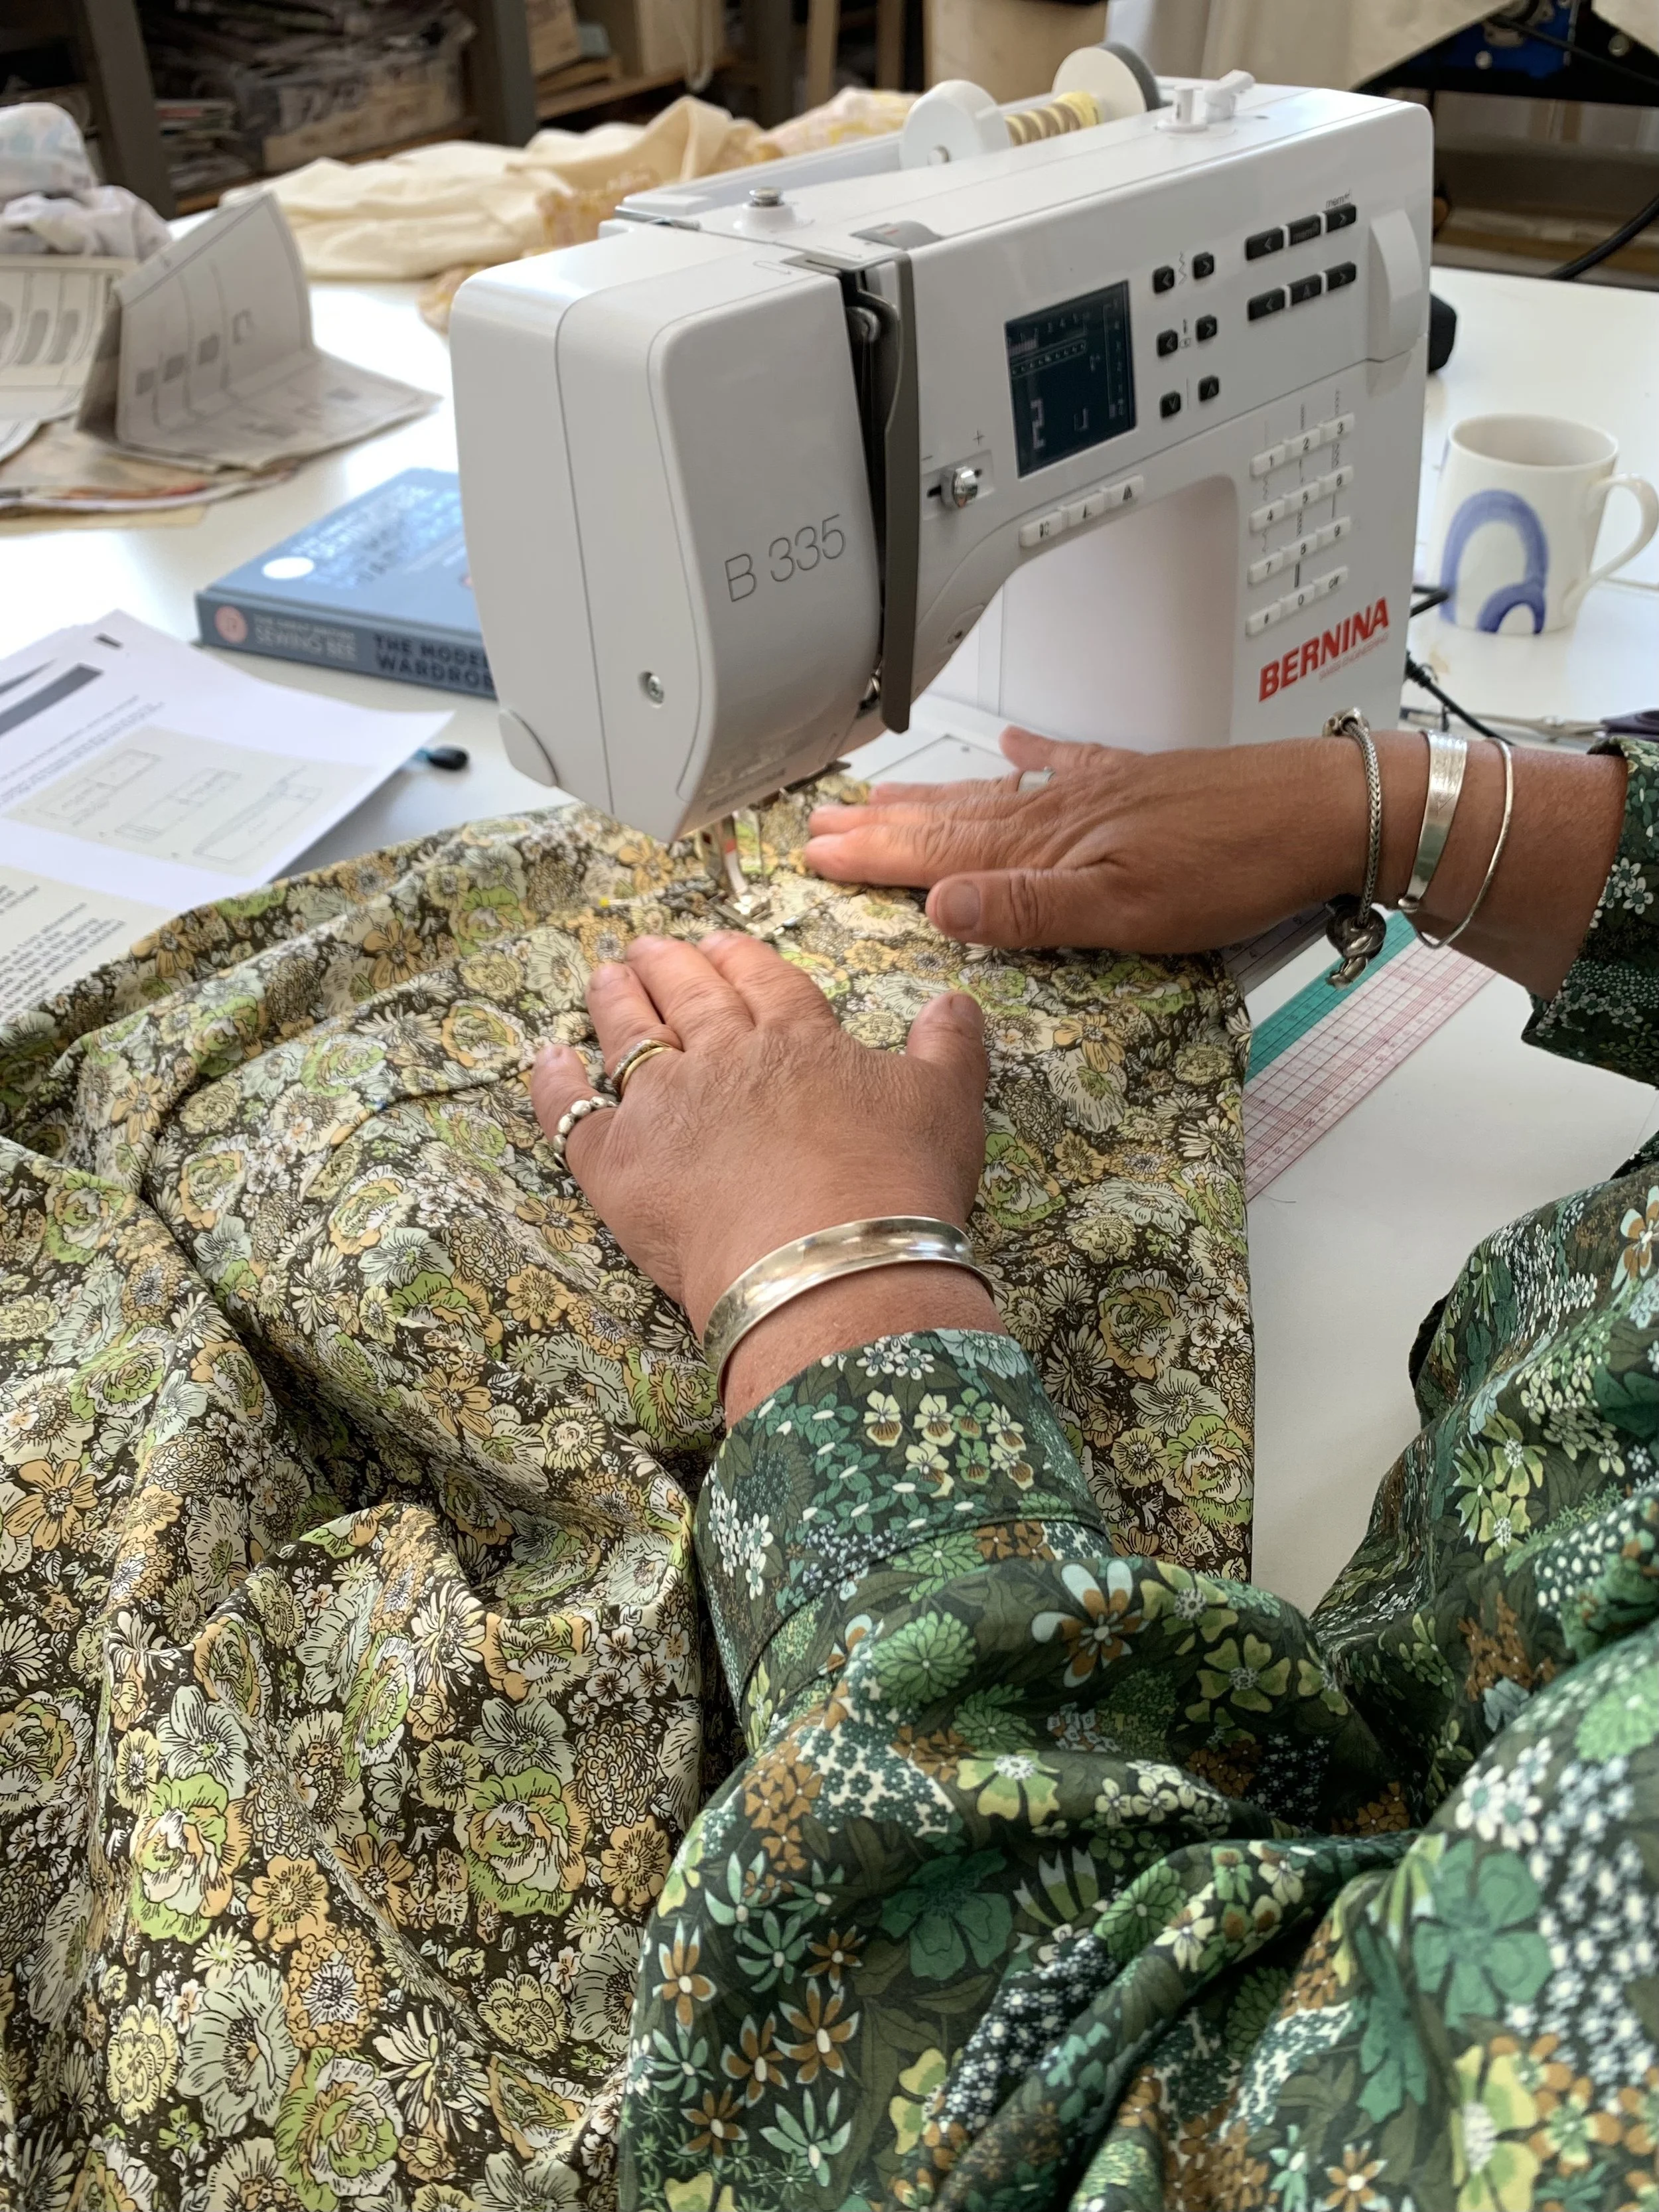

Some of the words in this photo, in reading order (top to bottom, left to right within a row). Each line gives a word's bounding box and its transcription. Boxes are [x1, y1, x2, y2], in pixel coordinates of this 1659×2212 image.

[1303, 437, 1310, 451] 2
[1337, 421, 1344, 435] 3
[1267, 509, 1273, 521] 4
[725, 553, 757, 602] B
[768, 514, 846, 582] 335
[1265, 561, 1272, 574] 7
[1300, 542, 1307, 555] 8
[1334, 524, 1341, 537] 9
[1298, 594, 1305, 606] 0
[374, 632, 412, 652] THE
[1258, 596, 1390, 703] BERNINA
